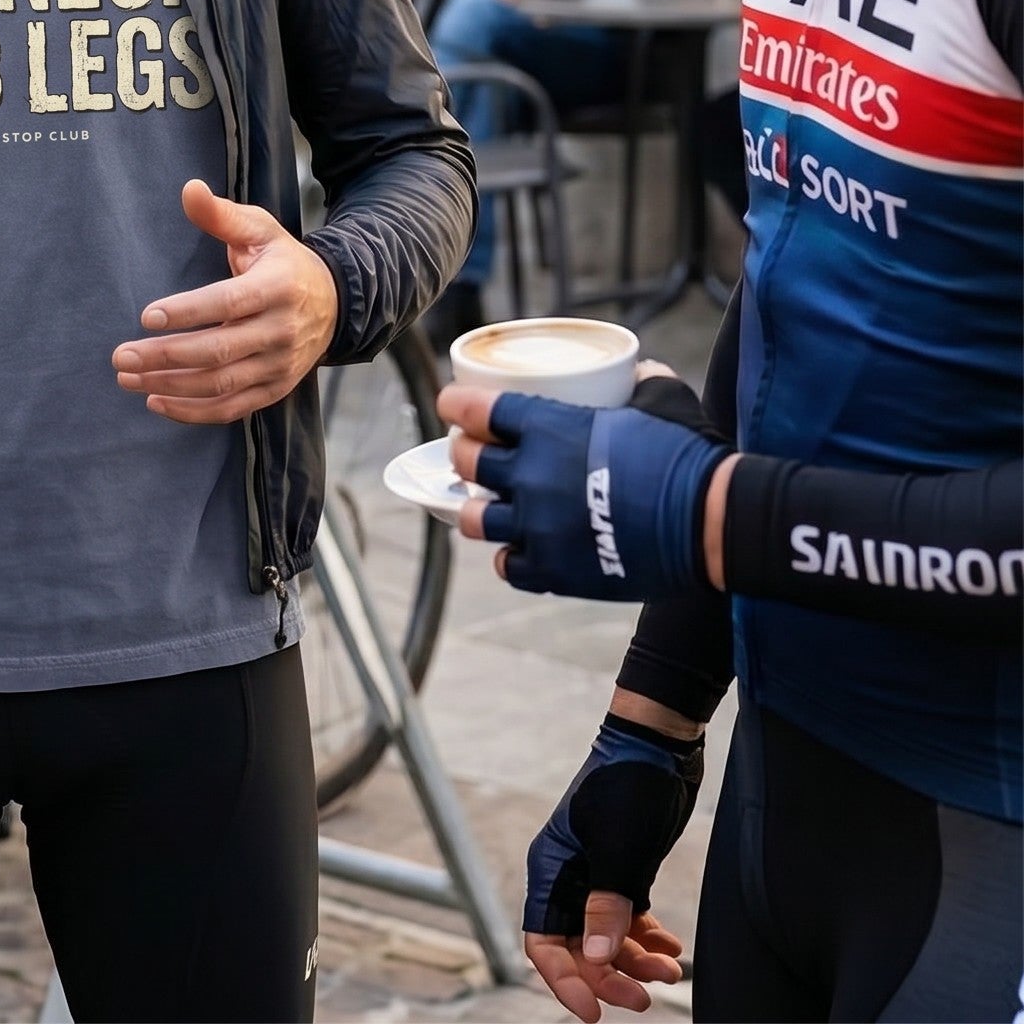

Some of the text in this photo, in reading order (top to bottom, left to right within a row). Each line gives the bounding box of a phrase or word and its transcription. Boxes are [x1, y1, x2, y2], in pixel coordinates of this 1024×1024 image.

[25, 15, 216, 116] LEGS
[740, 18, 900, 131] Emirates
[2, 131, 43, 143] STOP
[49, 130, 90, 141] CLUB
[800, 154, 908, 240] SORT
